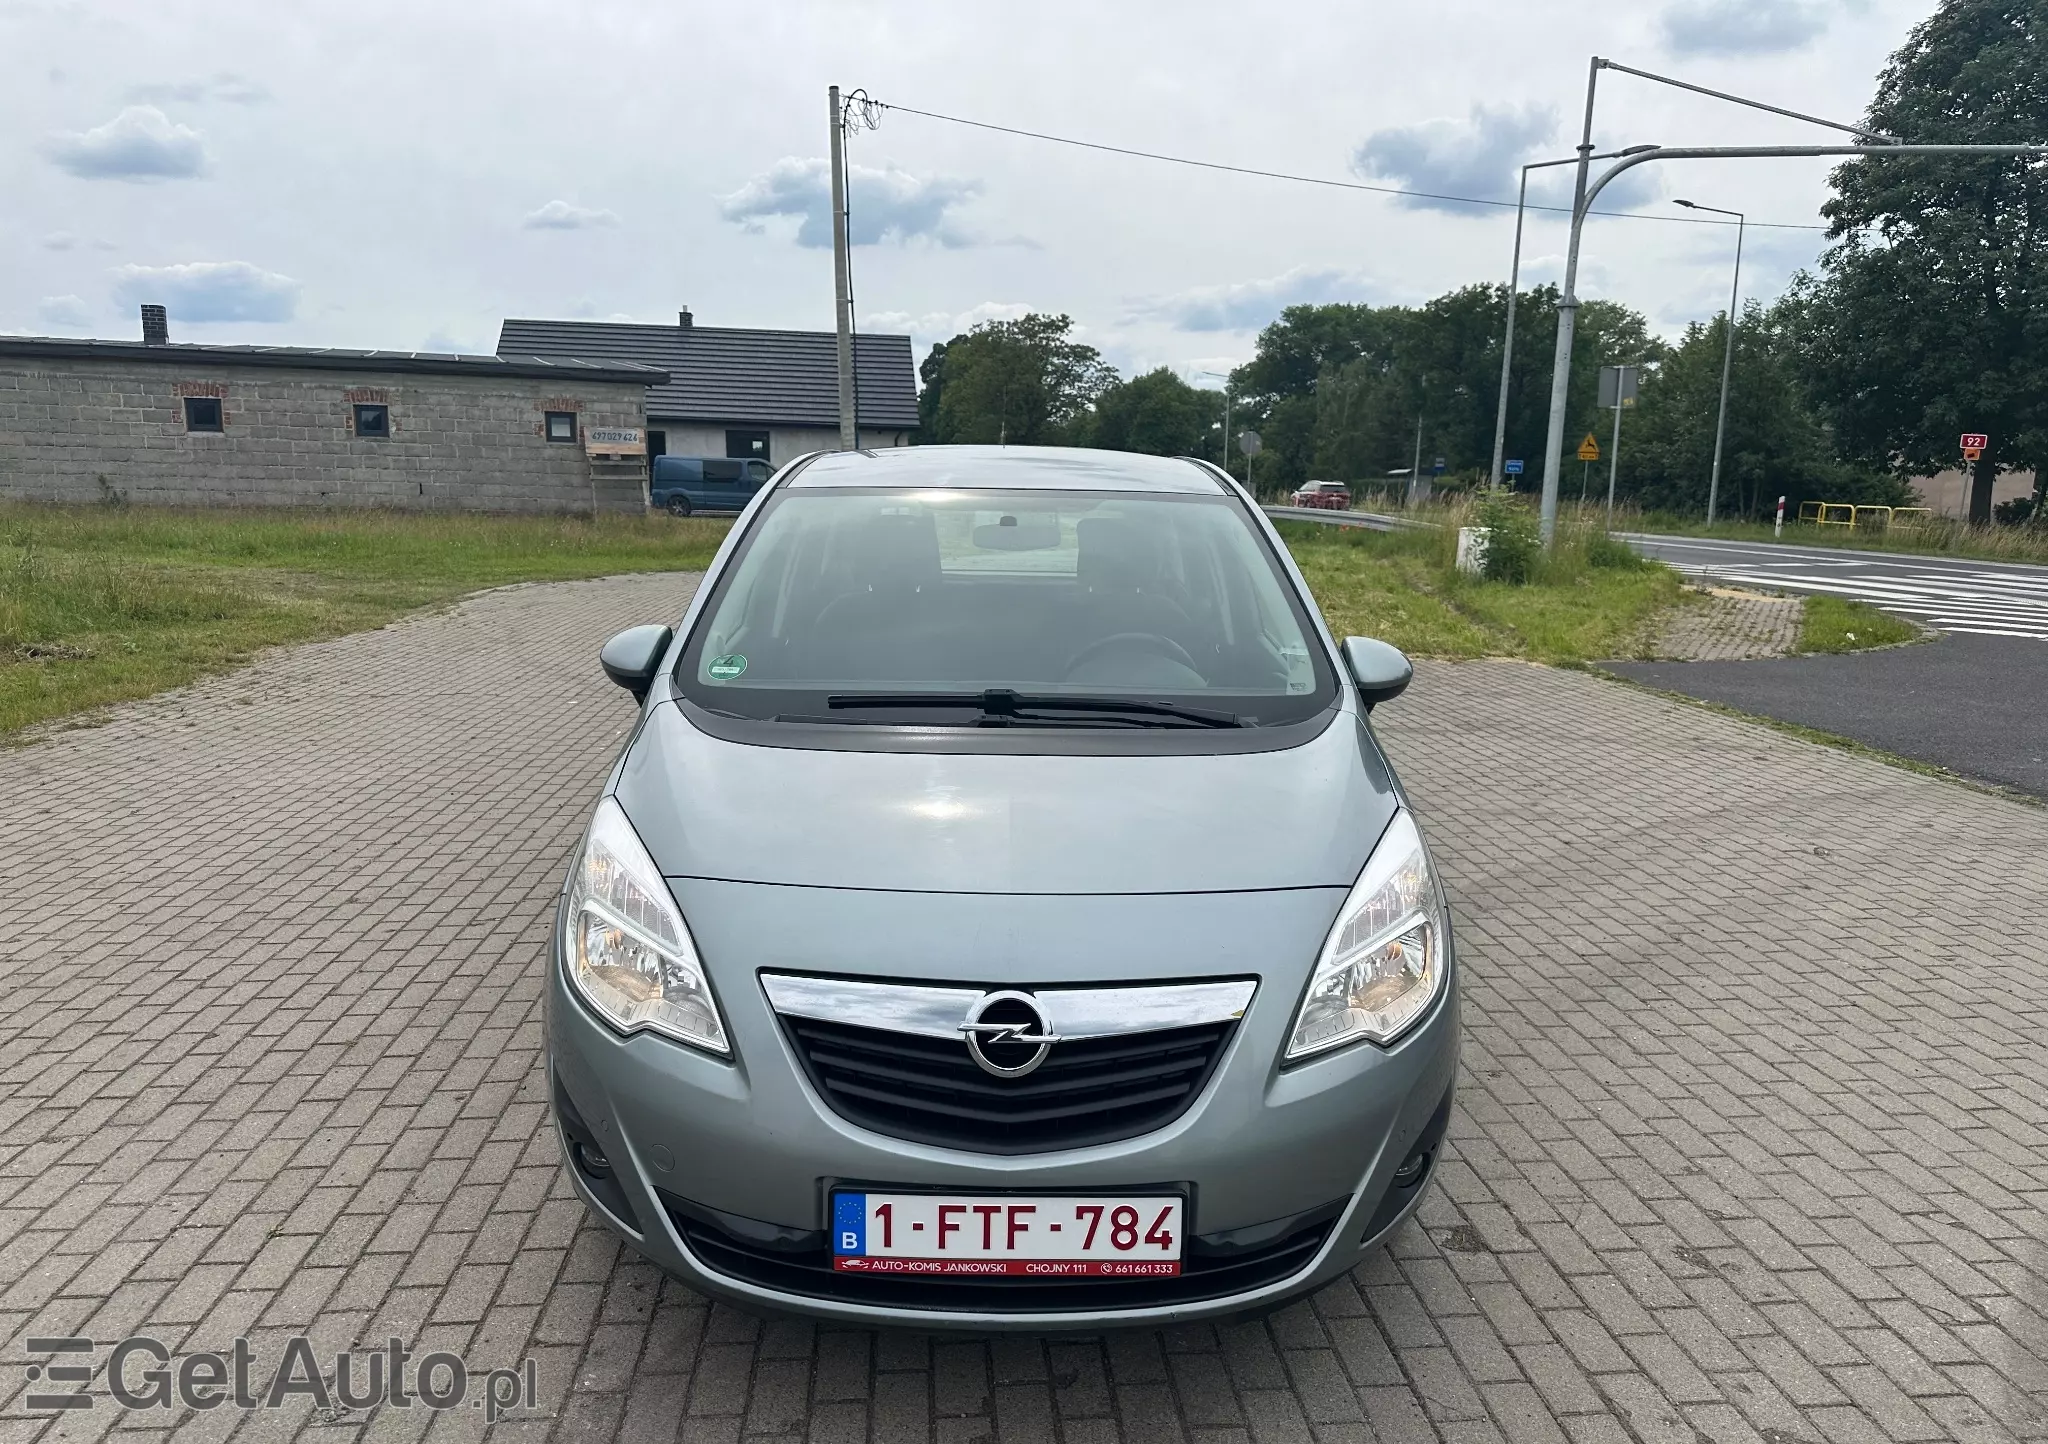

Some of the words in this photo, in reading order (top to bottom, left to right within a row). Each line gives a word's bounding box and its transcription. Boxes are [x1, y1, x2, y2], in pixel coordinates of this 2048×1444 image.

[1967, 437, 1981, 446] 92
[875, 1203, 1174, 1250] 1-FTF-784
[842, 1232, 858, 1249] B
[872, 1261, 942, 1272] AUTO-KOMIS
[944, 1263, 1007, 1273] JANKOWSKI
[1026, 1263, 1070, 1273] CHOJNY
[1073, 1264, 1087, 1273] 111
